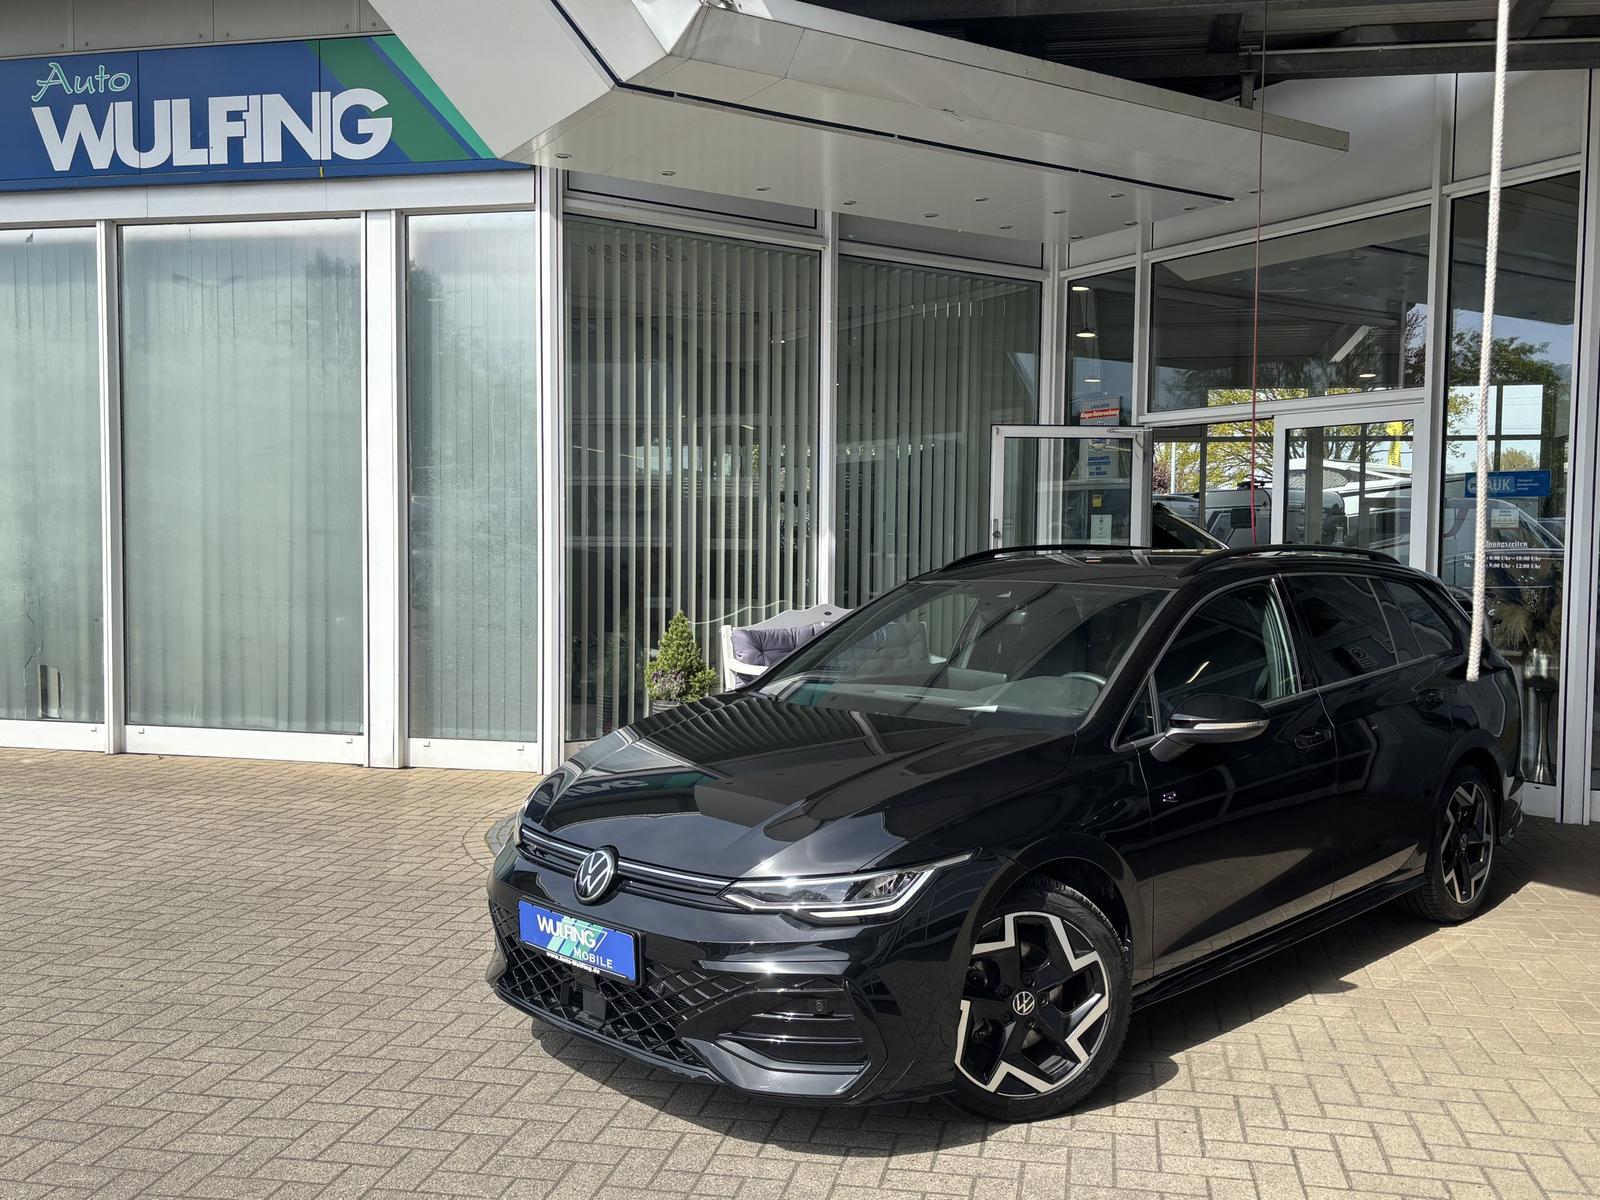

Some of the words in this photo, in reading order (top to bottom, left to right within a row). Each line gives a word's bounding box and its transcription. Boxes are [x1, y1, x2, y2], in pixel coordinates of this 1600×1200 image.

[31, 62, 131, 102] Auto
[31, 88, 393, 172] WULFING
[537, 914, 597, 948] WULFING
[573, 946, 613, 969] MOBILE
